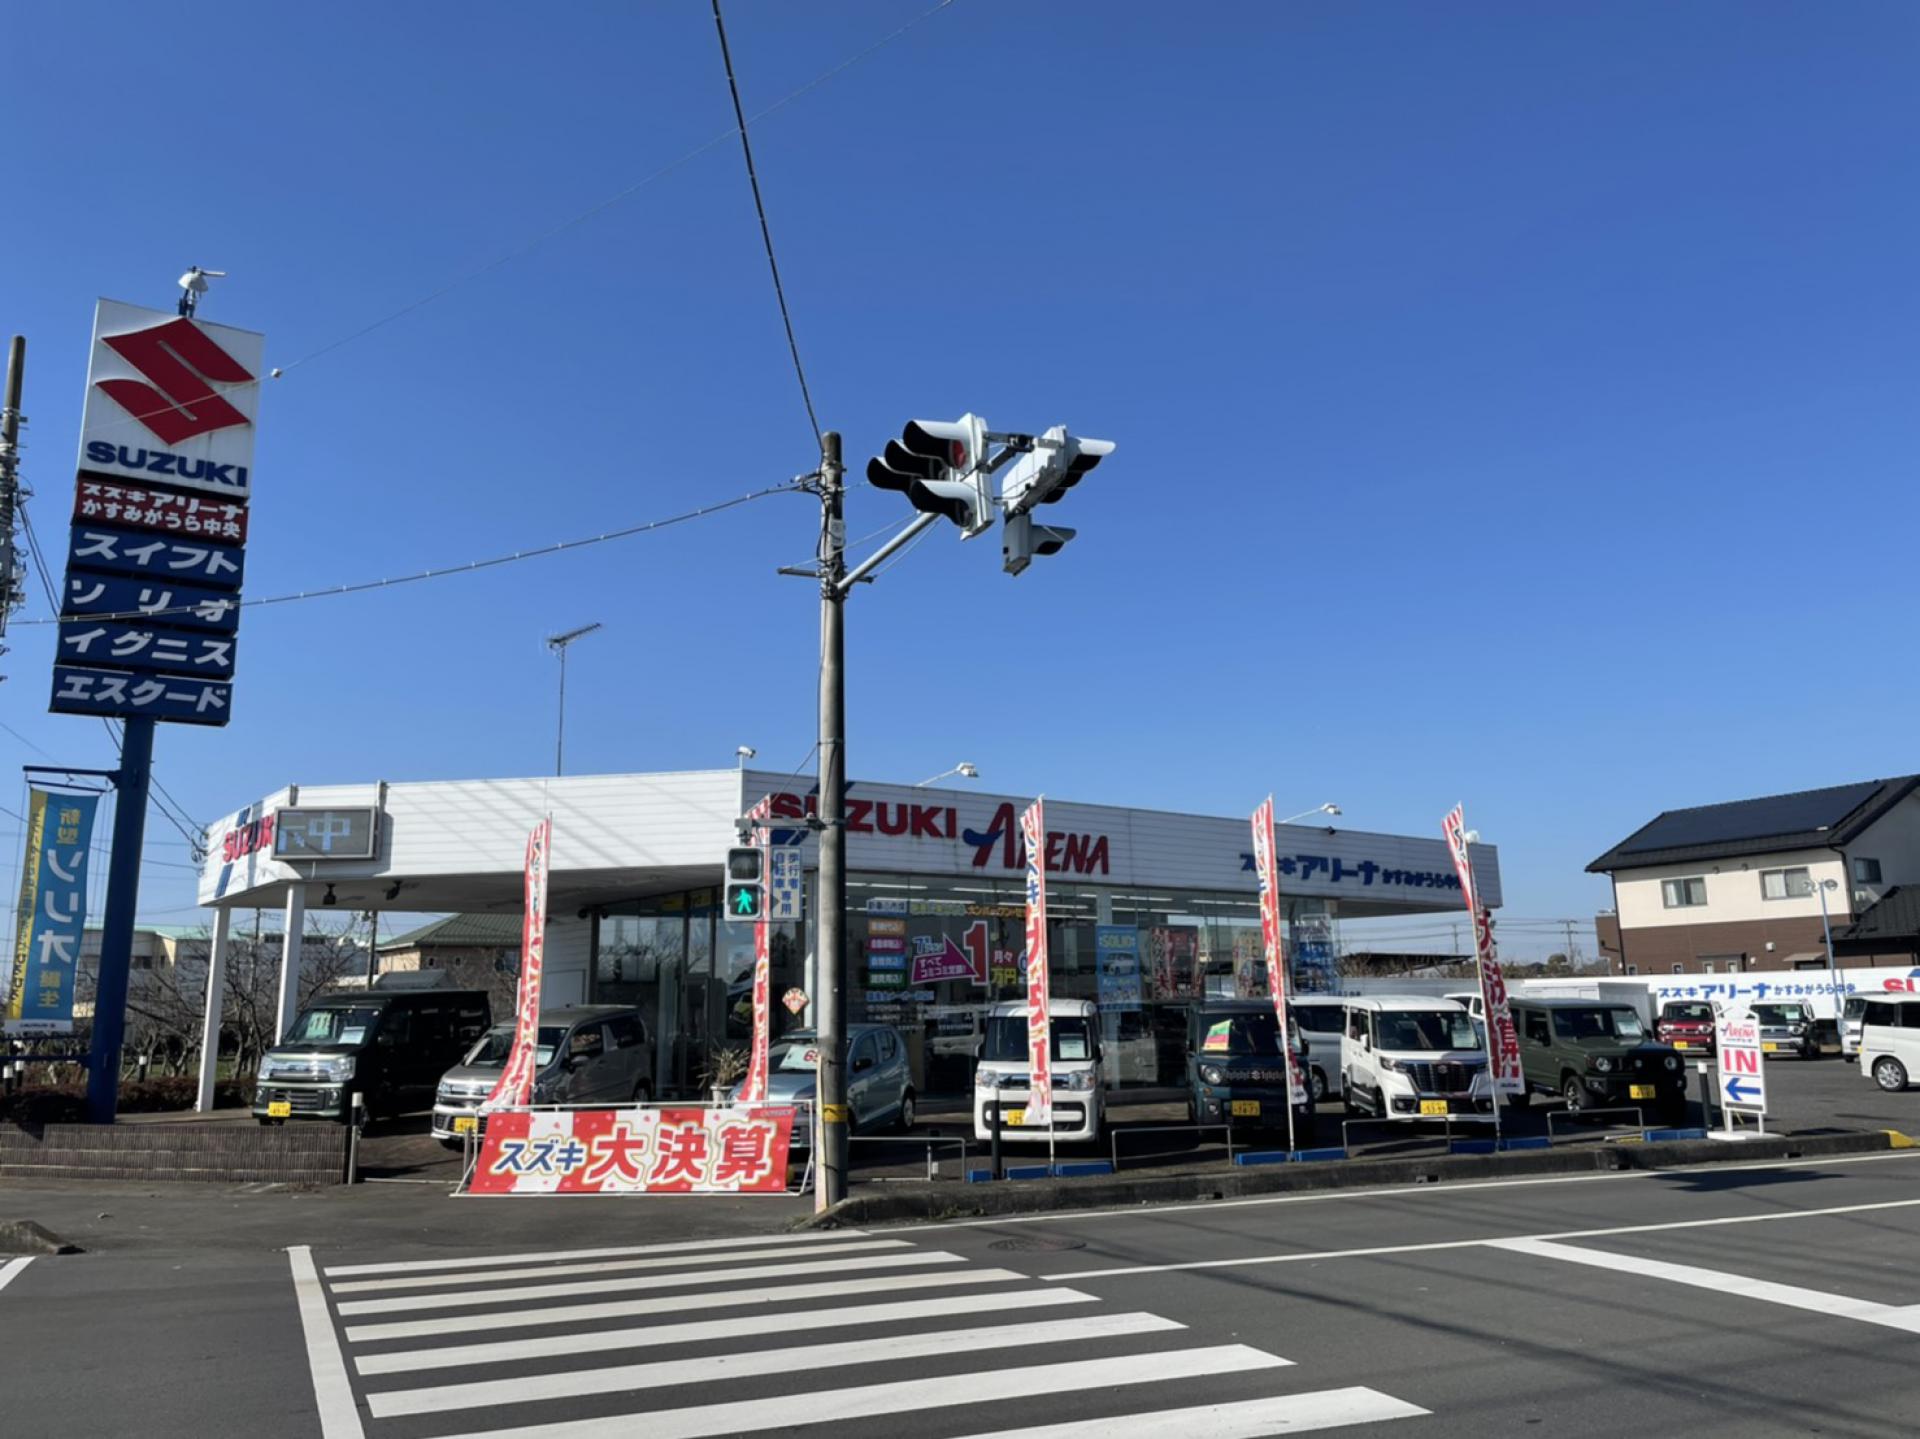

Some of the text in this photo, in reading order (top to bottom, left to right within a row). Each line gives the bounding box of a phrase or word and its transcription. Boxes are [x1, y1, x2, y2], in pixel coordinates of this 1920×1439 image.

[86, 440, 248, 488] SUZUKI
[80, 483, 244, 520] スズキアリーナ
[81, 498, 242, 538] かすみがうら中央
[75, 531, 239, 575] スイフト
[71, 579, 236, 622] ソリオ
[64, 628, 232, 666] イグニス
[55, 676, 228, 713] エスクード
[222, 814, 275, 863] SUZUK
[1723, 1049, 1758, 1073] IN
